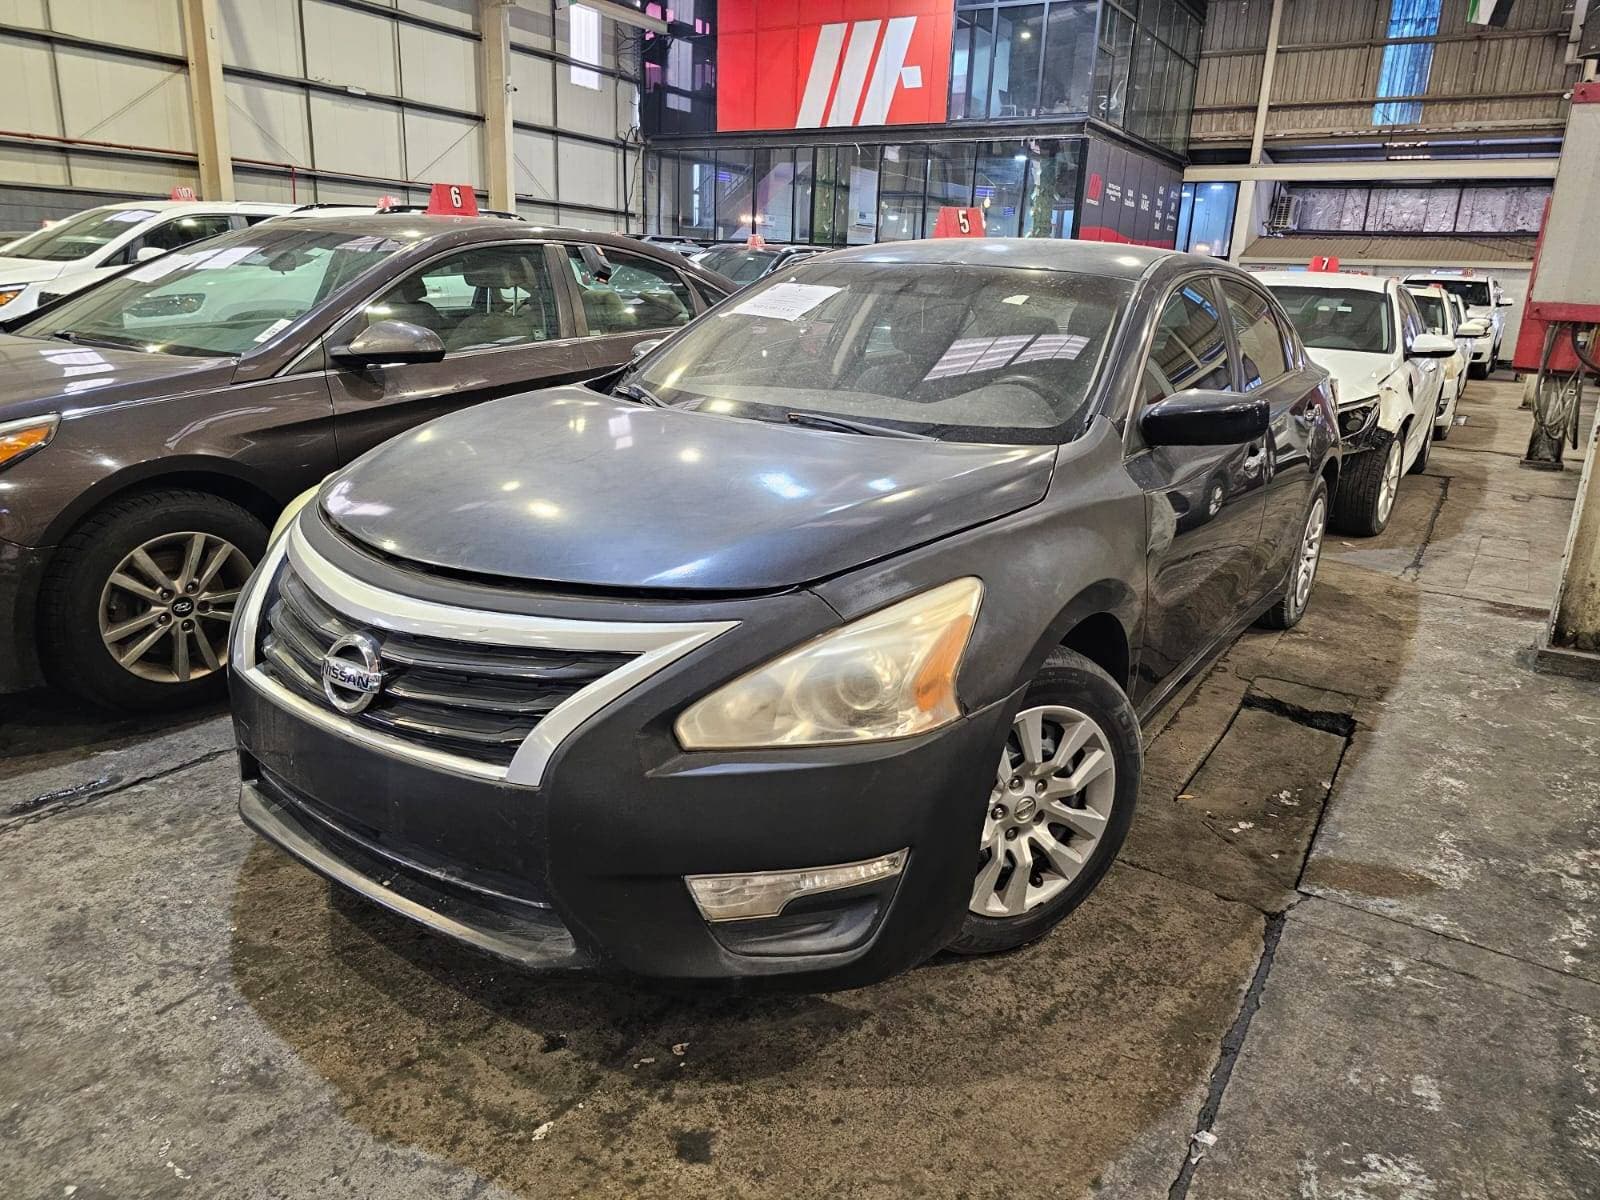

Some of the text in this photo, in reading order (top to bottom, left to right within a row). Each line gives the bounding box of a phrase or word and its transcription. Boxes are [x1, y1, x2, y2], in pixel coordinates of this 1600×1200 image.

[450, 186, 462, 208] 6
[958, 209, 970, 234] 5
[1321, 257, 1329, 271] 7
[321, 660, 370, 690] NISSAN
